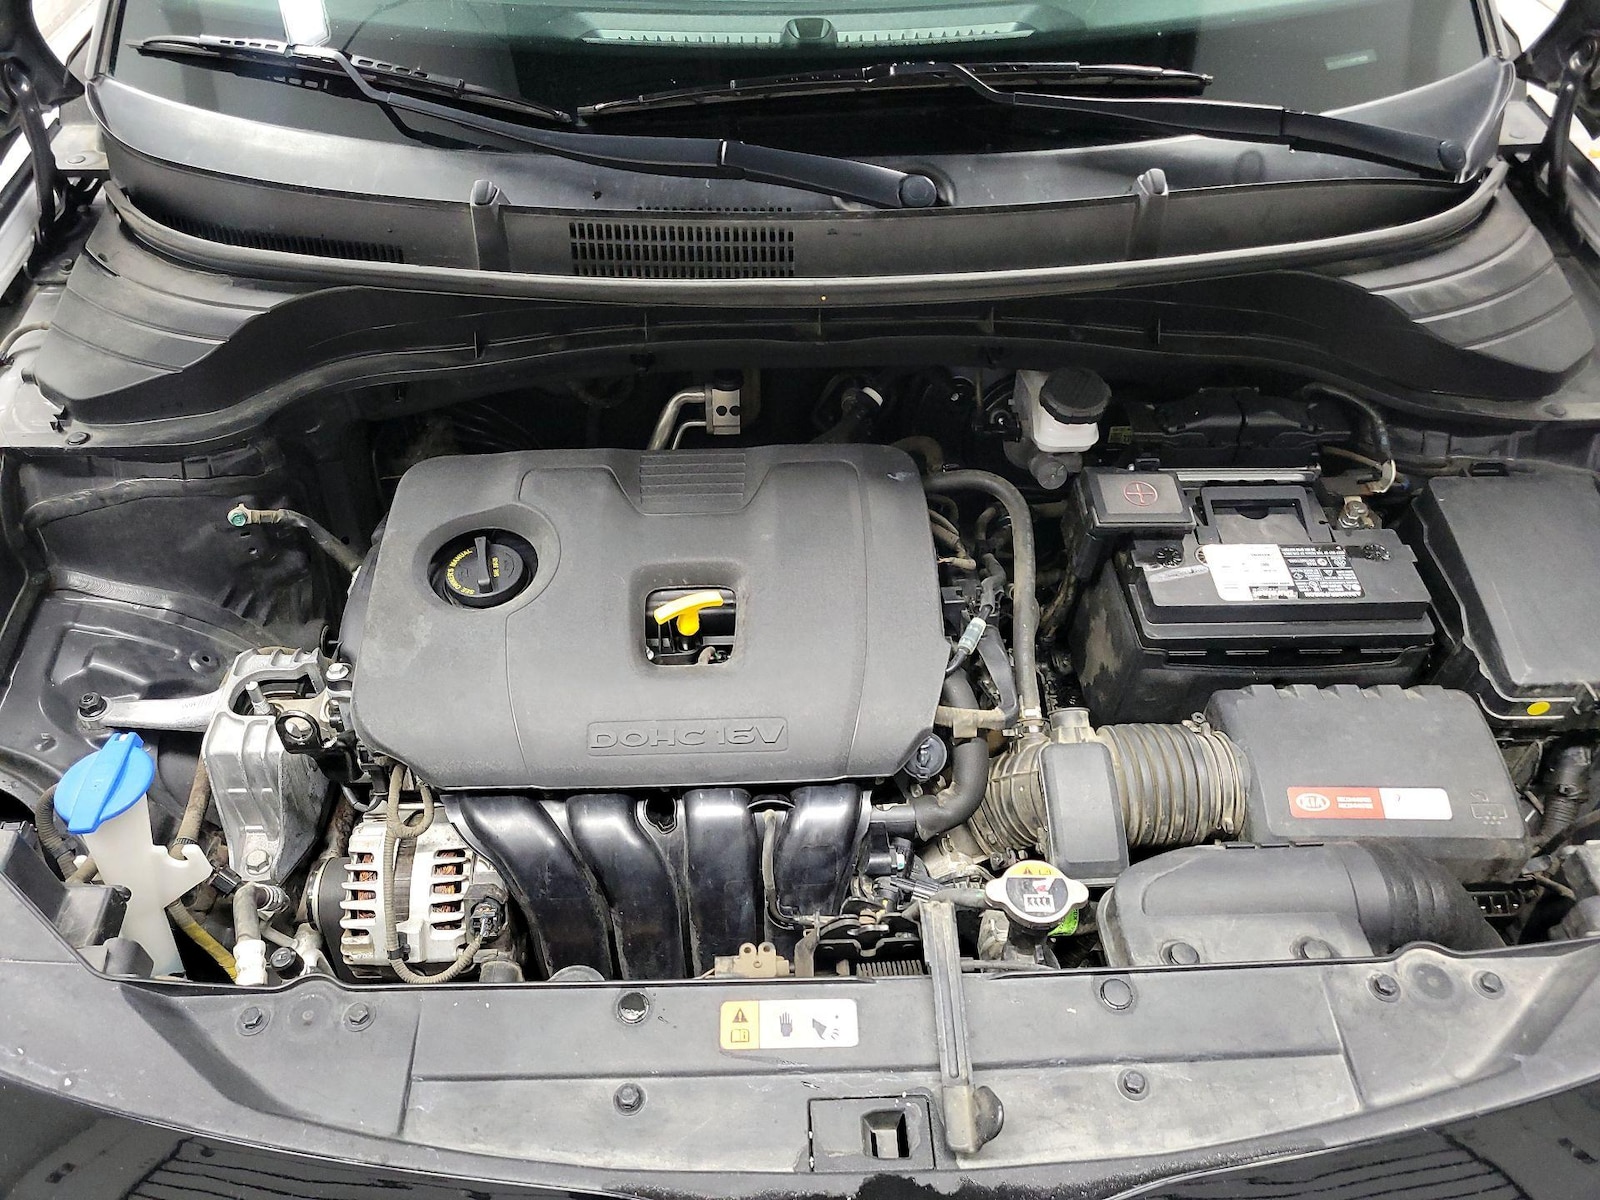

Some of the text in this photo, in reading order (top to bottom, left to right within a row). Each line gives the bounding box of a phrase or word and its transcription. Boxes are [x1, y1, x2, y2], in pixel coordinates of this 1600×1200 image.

[449, 549, 473, 567] MANUAL
[590, 724, 785, 749] DOHC 16V
[1298, 794, 1328, 810] KIA
